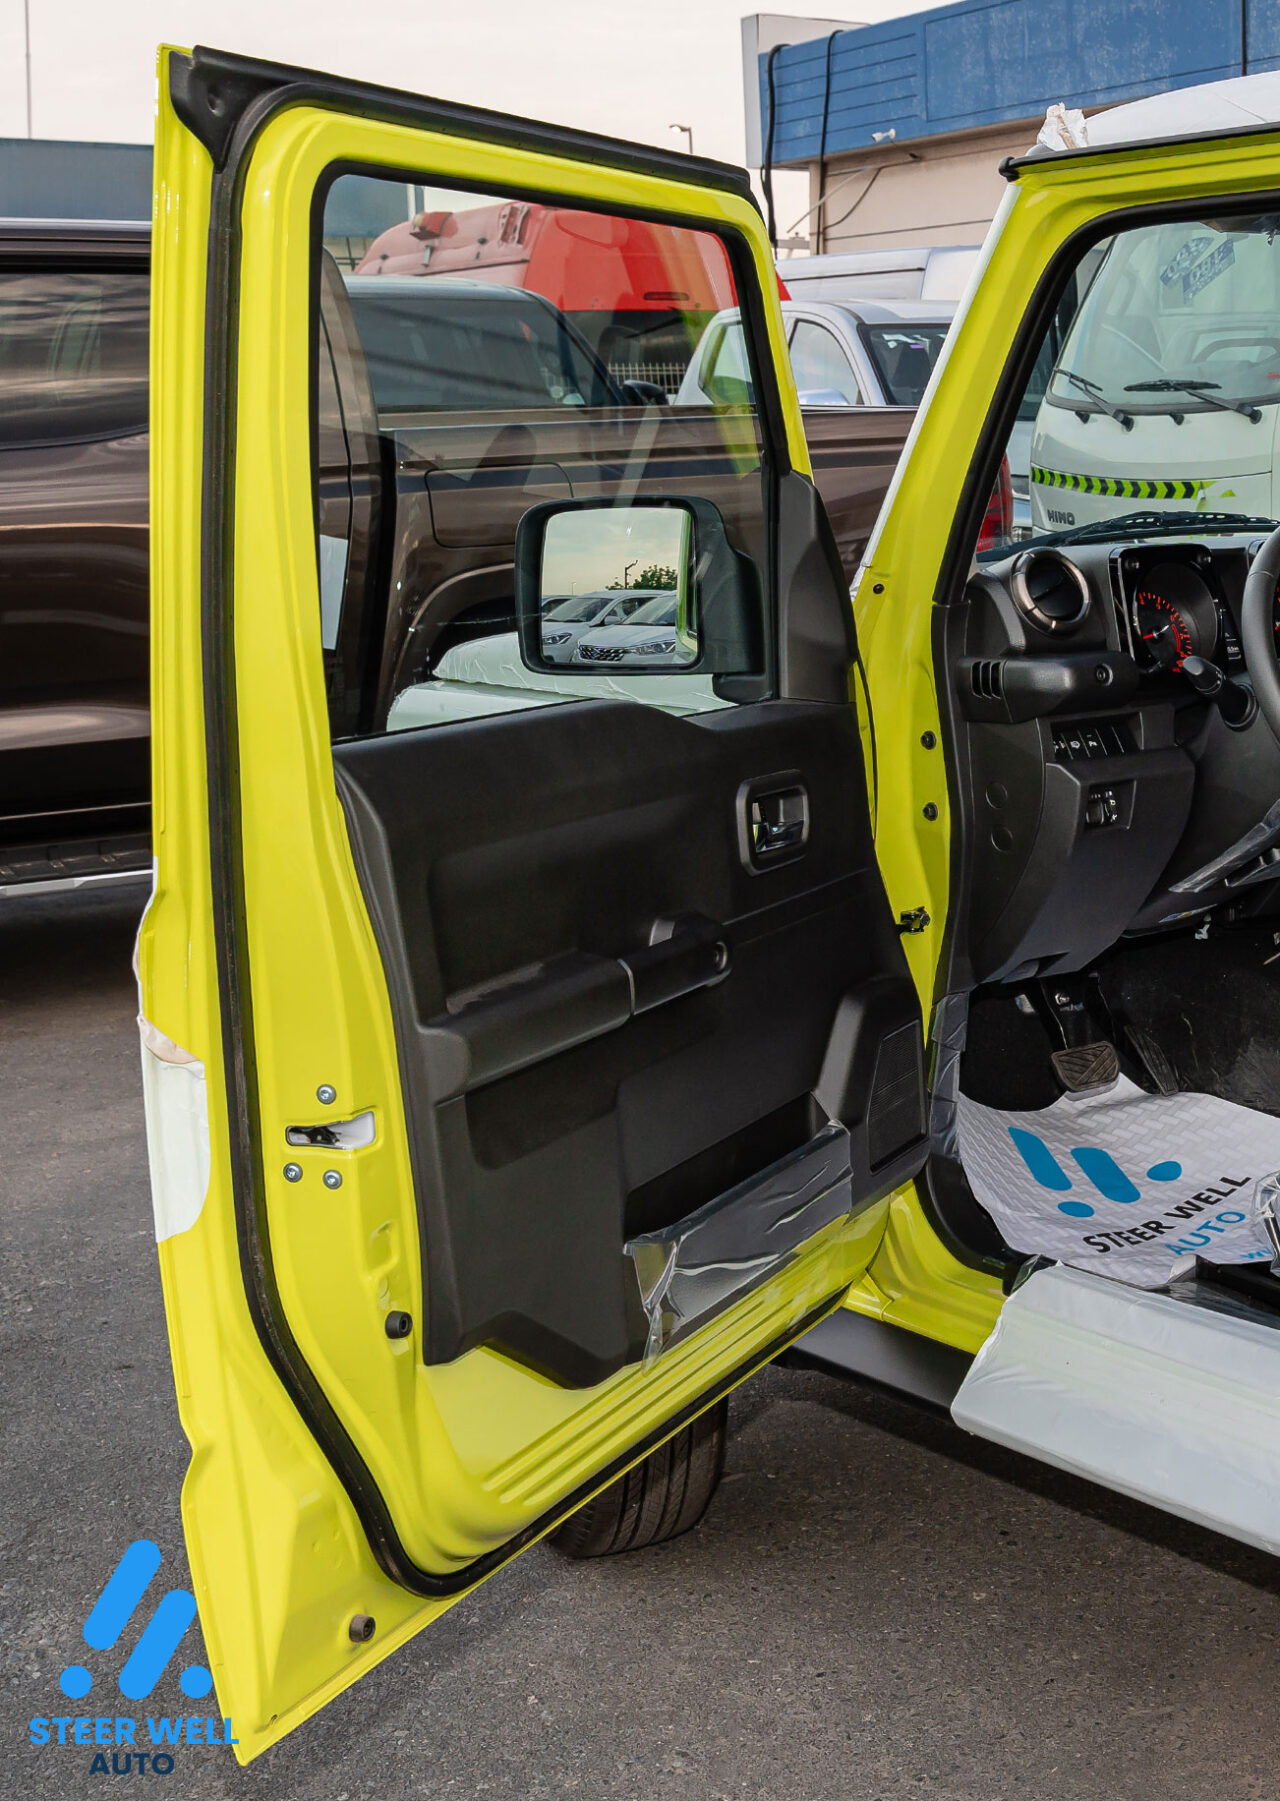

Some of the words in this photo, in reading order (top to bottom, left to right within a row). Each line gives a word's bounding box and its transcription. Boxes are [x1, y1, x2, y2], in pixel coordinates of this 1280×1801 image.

[1047, 509, 1075, 525] HINO
[1083, 1220, 1176, 1253] STEER
[1163, 1176, 1252, 1219] WELL
[1164, 1211, 1246, 1256] AUTO
